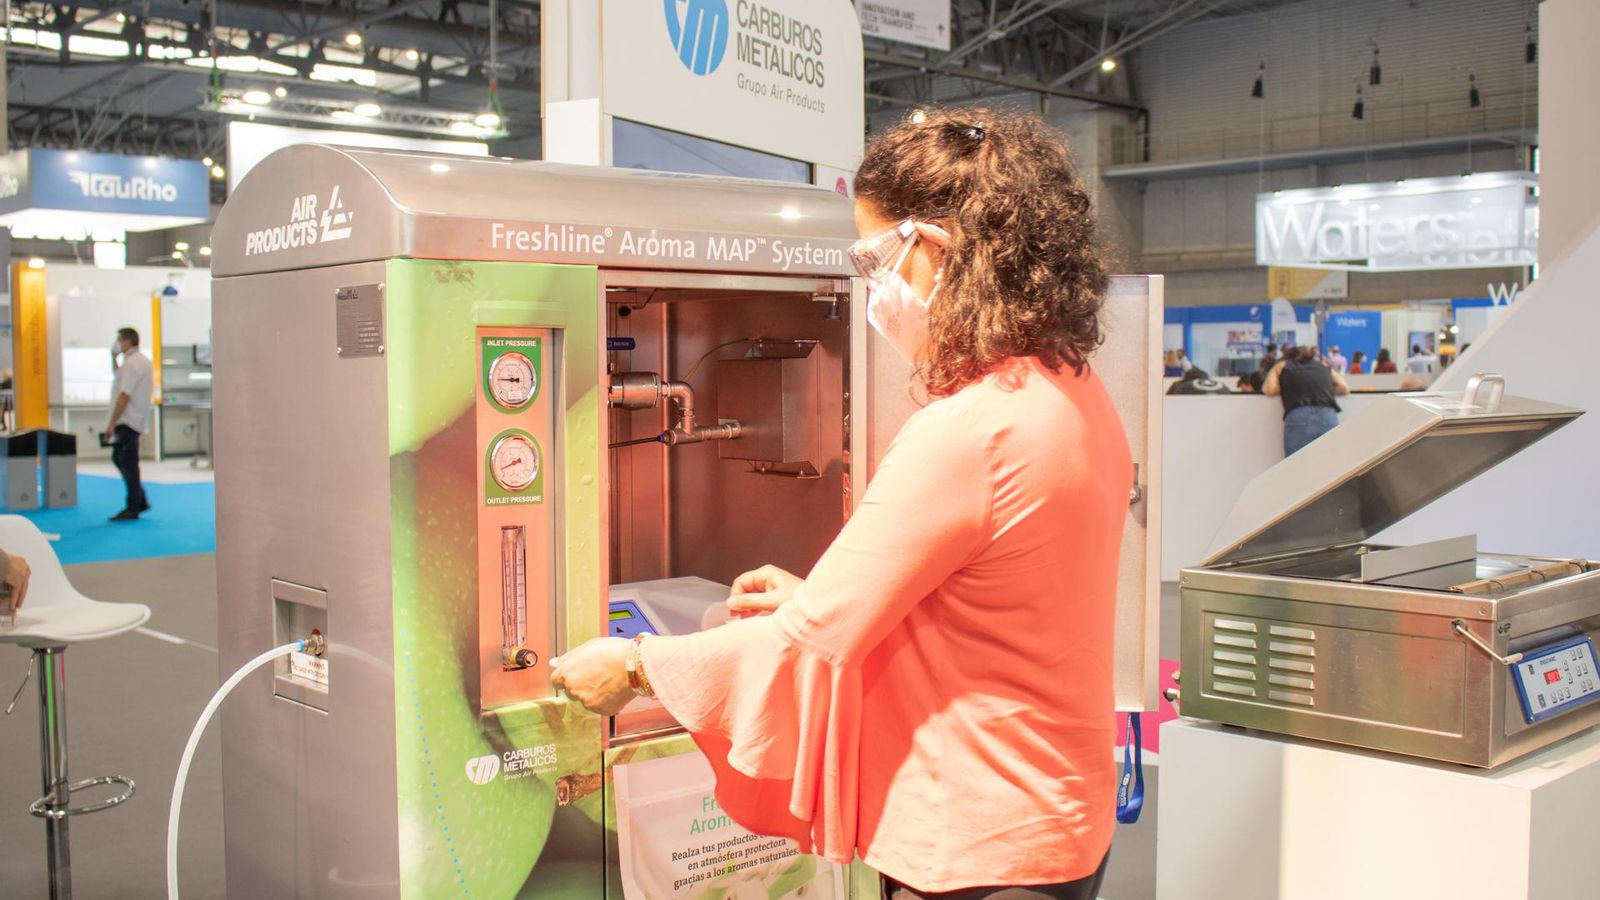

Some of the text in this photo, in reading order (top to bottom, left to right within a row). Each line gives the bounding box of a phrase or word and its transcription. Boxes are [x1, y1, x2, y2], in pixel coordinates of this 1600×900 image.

[736, 0, 823, 56] CARBUROS
[736, 31, 825, 89] METALICOS
[736, 72, 825, 114] Grupo Air Products
[290, 194, 318, 223] AIR
[245, 219, 318, 256] PRODUCTS
[1262, 202, 1455, 260] Waters
[771, 240, 843, 271] System
[505, 339, 537, 347] PRESSURE
[486, 495, 542, 505] OUTLET PRESSURE
[503, 743, 557, 762] CARBUROS
[503, 754, 558, 773] METALICOS
[671, 848, 701, 862] Realza
[701, 845, 716, 855] tus
[717, 832, 759, 853] productos
[687, 838, 787, 872] en atmósfera protectora
[673, 847, 800, 890] gracias a los aromas naturales.
